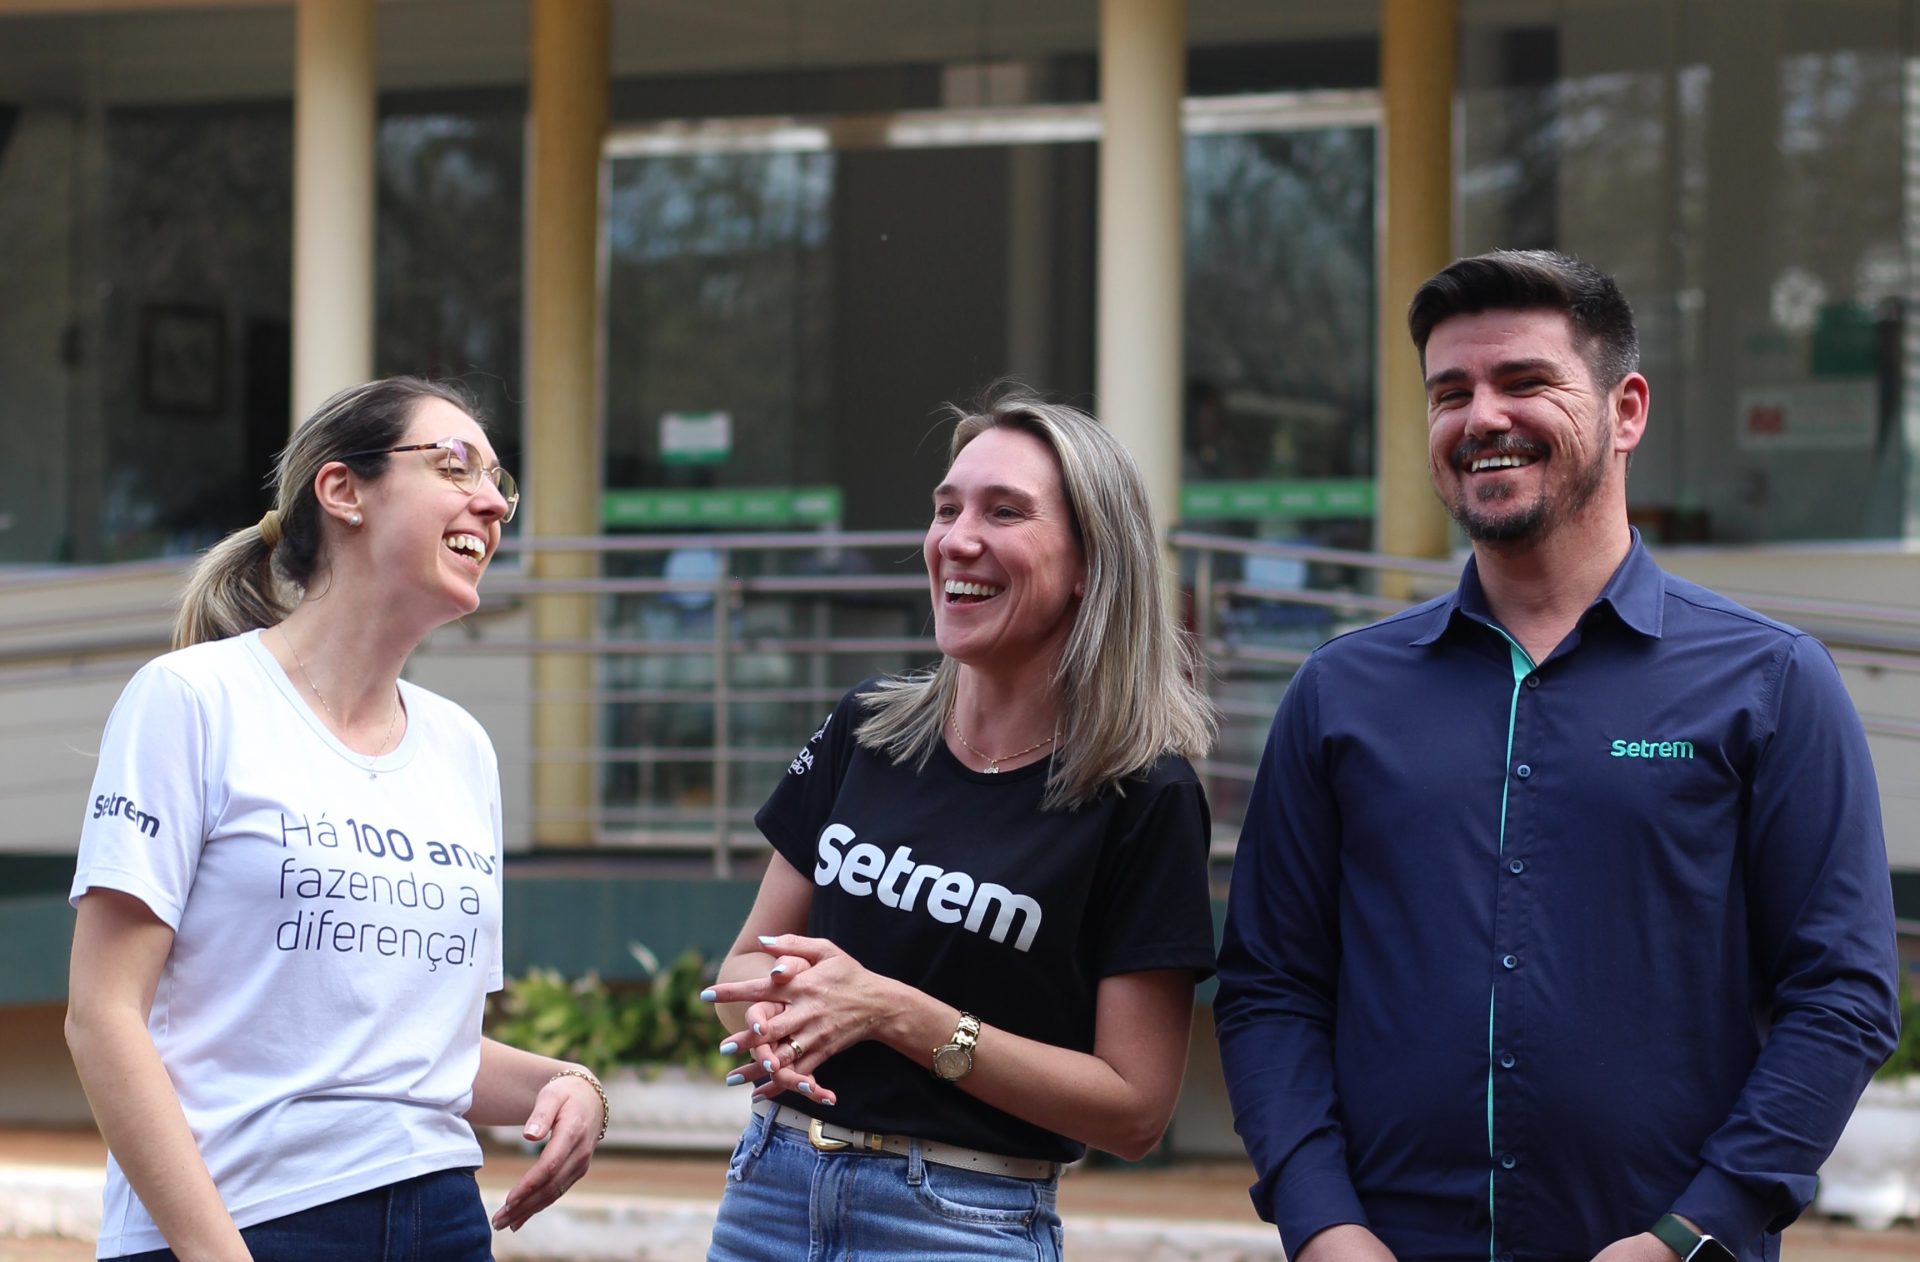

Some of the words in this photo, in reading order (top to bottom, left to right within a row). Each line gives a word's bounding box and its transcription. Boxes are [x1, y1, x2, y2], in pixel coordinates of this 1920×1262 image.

[1610, 739, 1694, 759] Setrem
[280, 812, 338, 848] Há
[346, 818, 414, 862] 100
[279, 857, 444, 910] fazendo
[460, 886, 480, 915] a
[814, 823, 1042, 952] Setrem
[276, 909, 478, 972] diferença!
